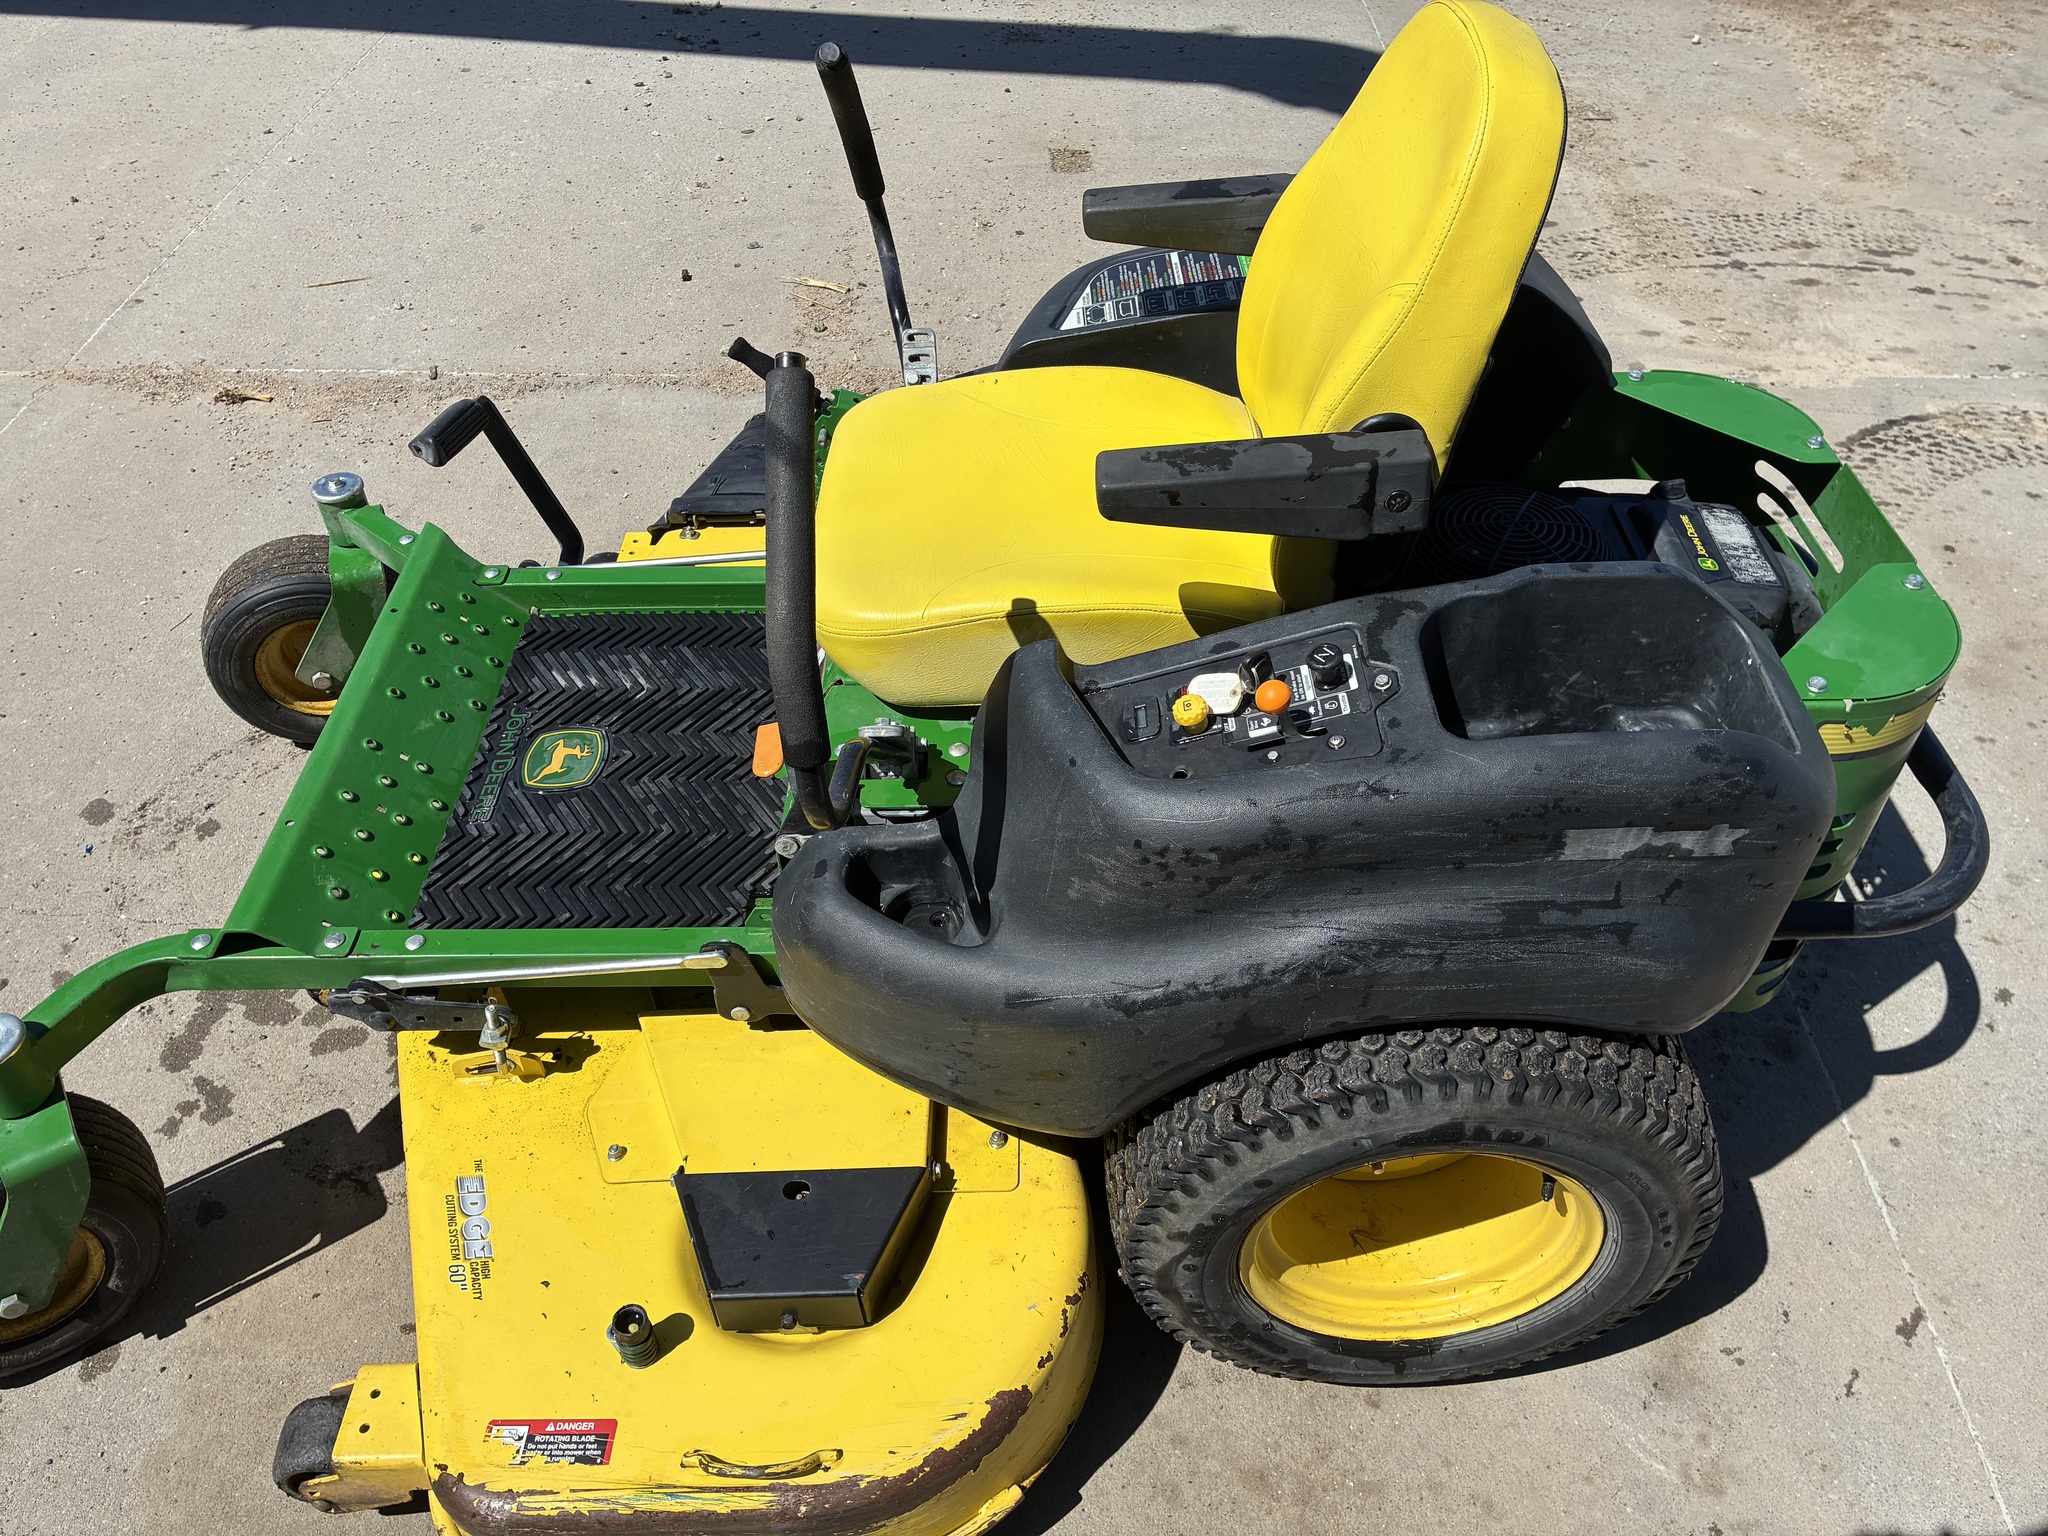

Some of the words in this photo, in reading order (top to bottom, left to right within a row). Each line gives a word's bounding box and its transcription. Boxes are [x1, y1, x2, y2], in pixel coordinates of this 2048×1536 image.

[1679, 514, 1698, 537] DEERE
[1691, 537, 1709, 557] JOHN
[1341, 694, 1349, 712] Throttle
[496, 707, 531, 756] JOHN
[469, 757, 516, 822] DEERE
[474, 1159, 484, 1173] THE
[445, 1194, 457, 1227] CUTTING
[457, 1174, 494, 1260] EDGE
[448, 1228, 461, 1261] SYSTEM
[448, 1264, 468, 1291] 60"
[469, 1261, 483, 1301] CAPACITY
[480, 1260, 491, 1280] HIGH
[555, 1422, 595, 1431] DANGER
[547, 1443, 558, 1451] put
